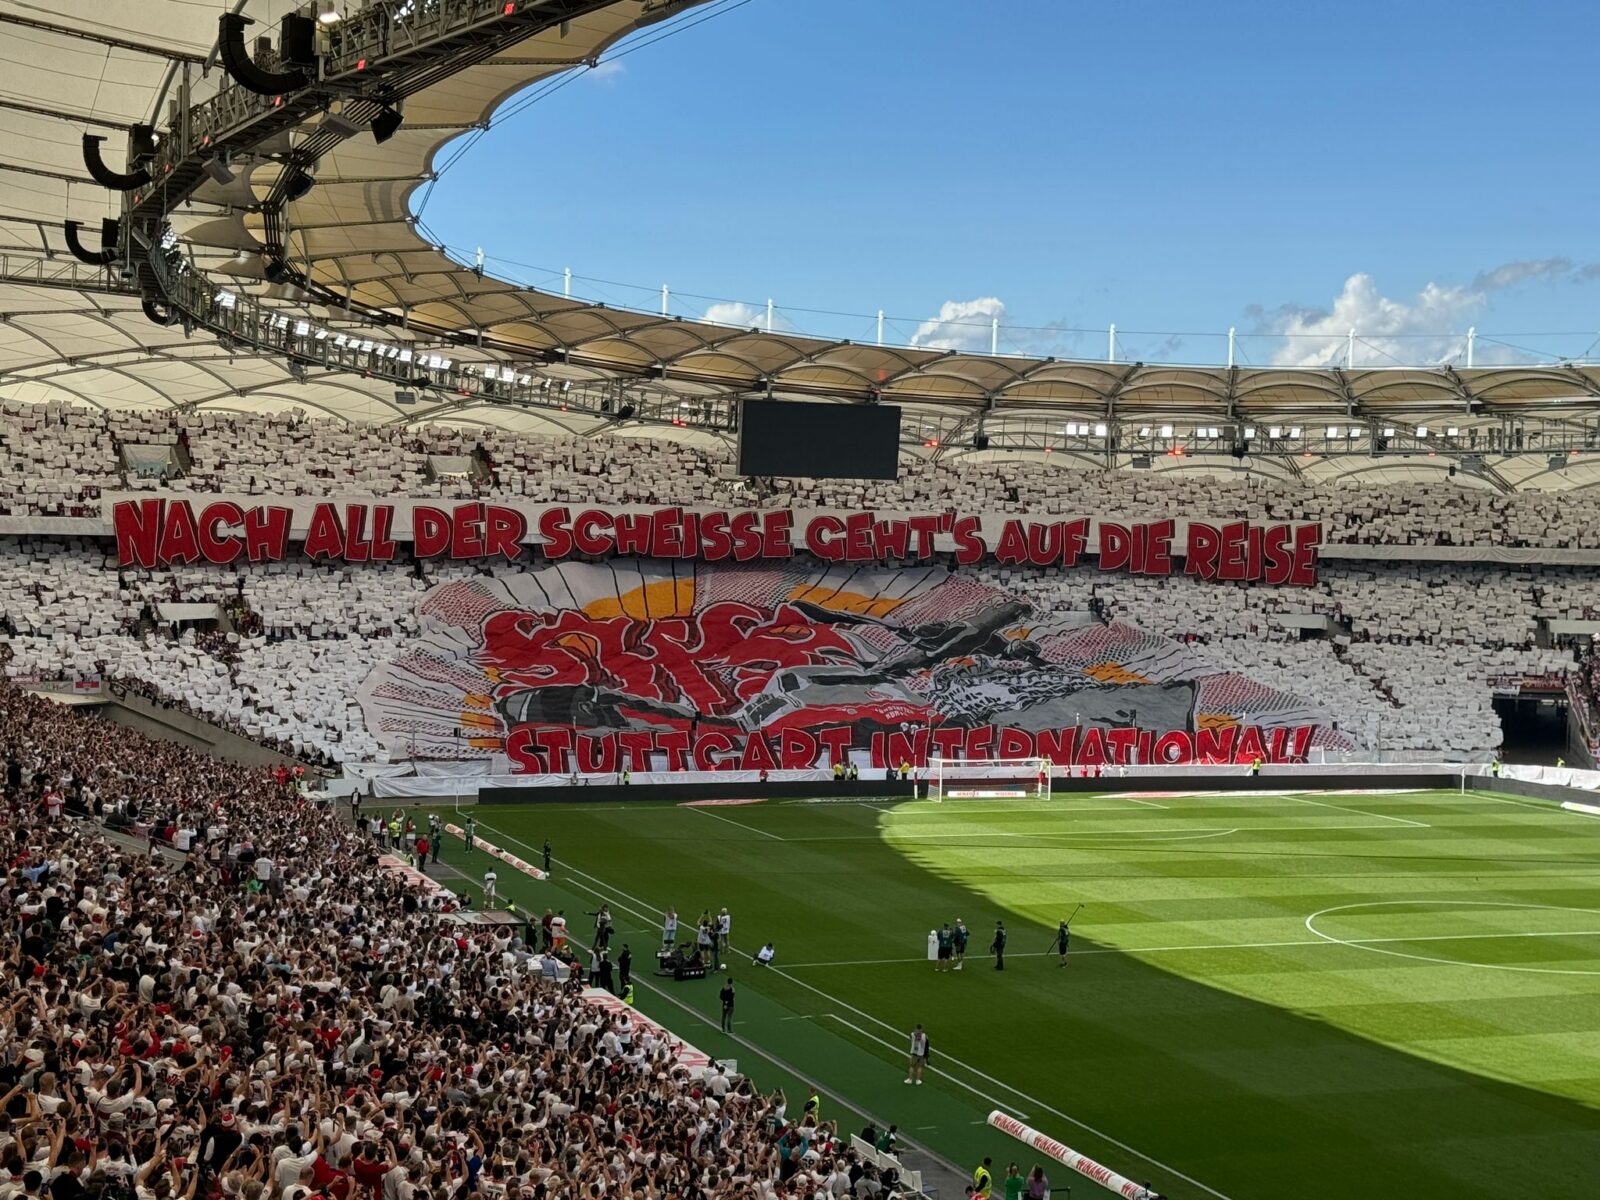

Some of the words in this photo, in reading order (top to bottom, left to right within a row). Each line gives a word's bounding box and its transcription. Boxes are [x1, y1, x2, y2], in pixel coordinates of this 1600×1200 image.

[113, 499, 293, 569] NACH
[303, 502, 397, 562] ALL
[412, 502, 526, 560] DER
[539, 506, 794, 562] SCHEISSE
[805, 508, 987, 566] GEHT'S
[995, 517, 1090, 567] AUF
[1099, 518, 1175, 575] DIE
[1184, 520, 1322, 587] REISE
[506, 726, 853, 774] STUTTGART
[871, 723, 1319, 768] INTERNATIONAL!
